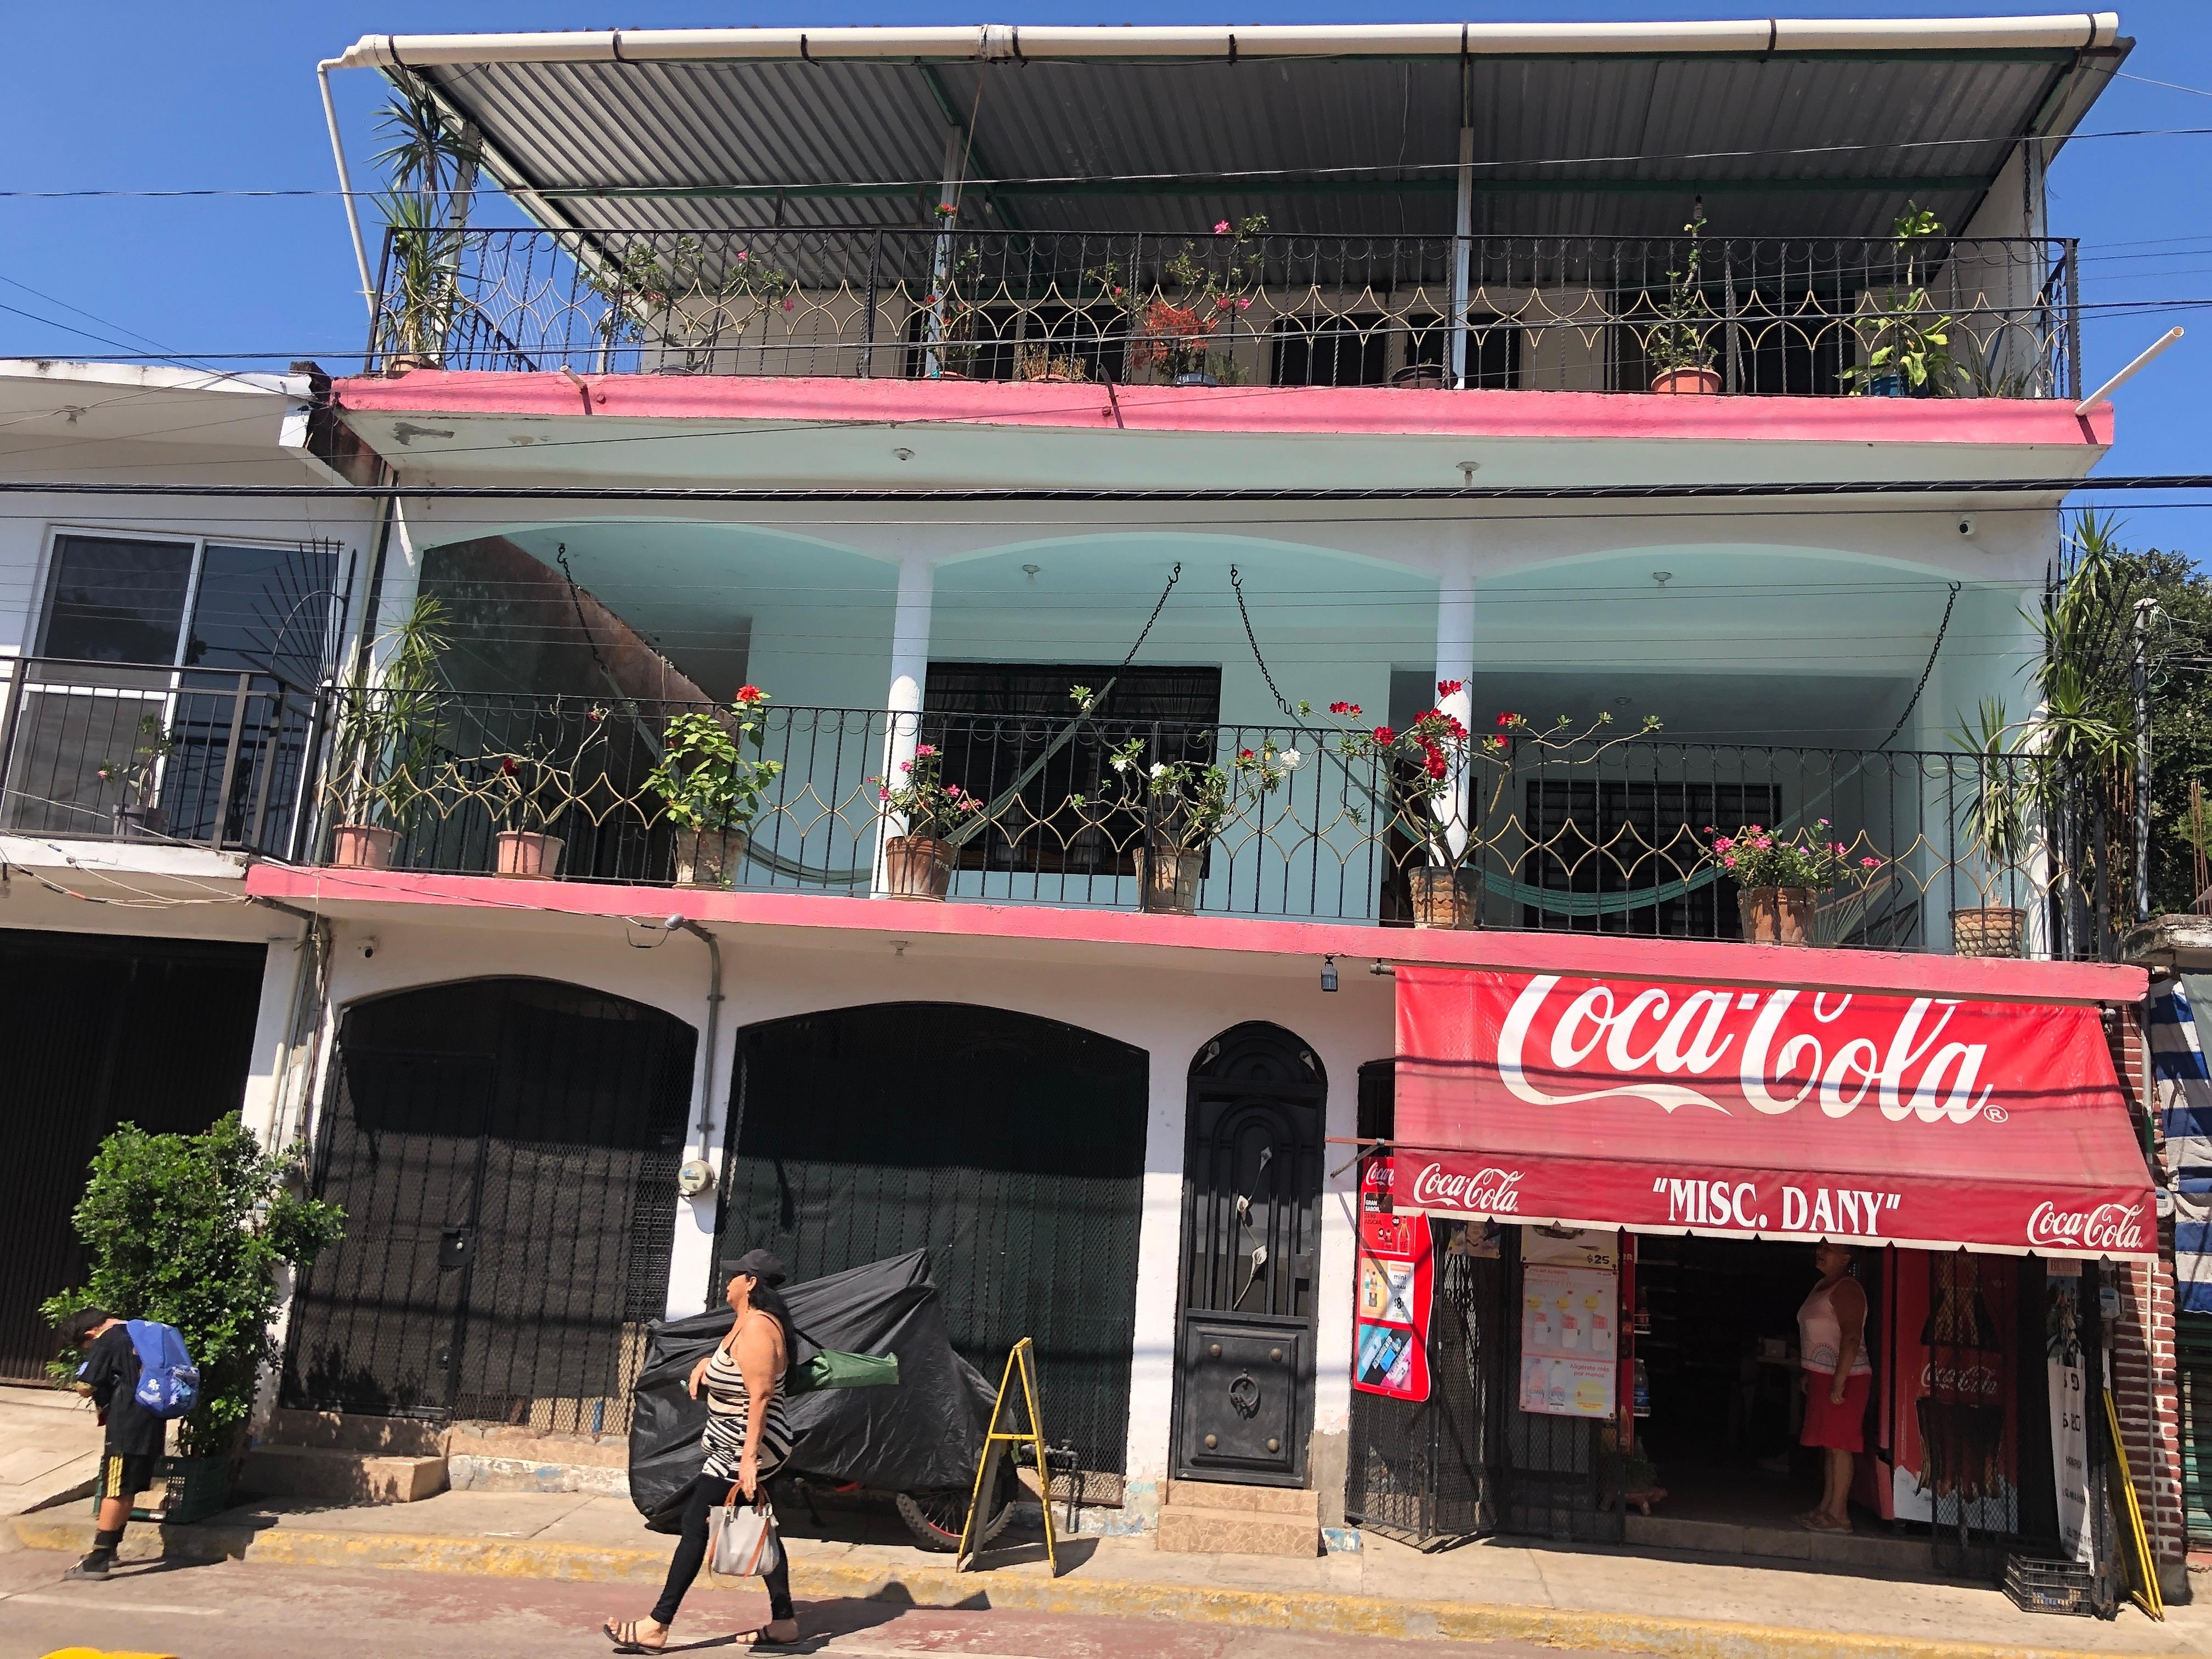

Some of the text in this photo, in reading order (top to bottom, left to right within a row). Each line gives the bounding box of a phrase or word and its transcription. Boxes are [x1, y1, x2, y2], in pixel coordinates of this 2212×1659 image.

[1497, 975, 1994, 1124] Coca-Cola
[1413, 1163, 1526, 1212] Coca-Cola
[1652, 1177, 1902, 1235] "MISC. DANY"
[2027, 1200, 2146, 1249] Coca-Cola
[1586, 1254, 1610, 1264] $25
[1570, 1363, 1596, 1372] Aligérate
